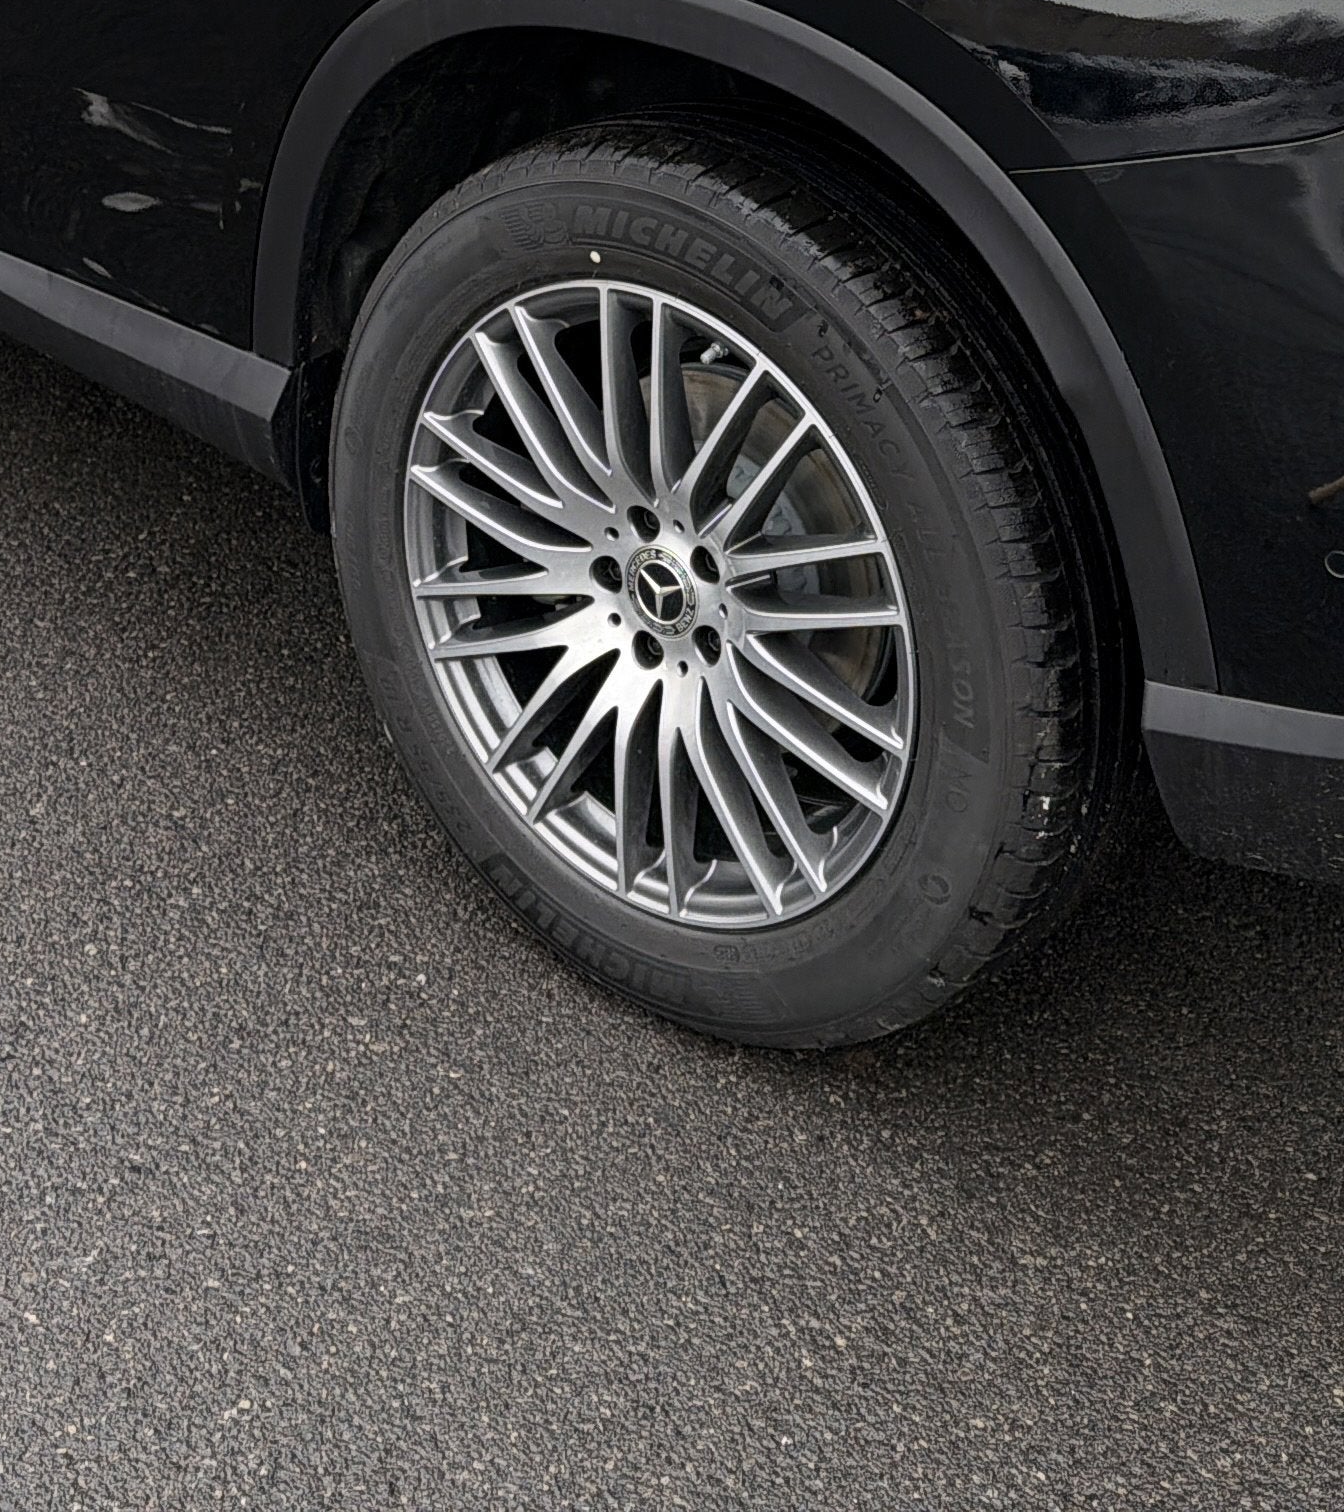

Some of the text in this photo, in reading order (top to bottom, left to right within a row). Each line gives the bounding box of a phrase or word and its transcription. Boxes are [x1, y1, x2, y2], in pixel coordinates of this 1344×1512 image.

[572, 204, 794, 321] MICHELIN
[810, 344, 917, 484] PRIMACY
[628, 548, 695, 633] MERCEDES BENZ
